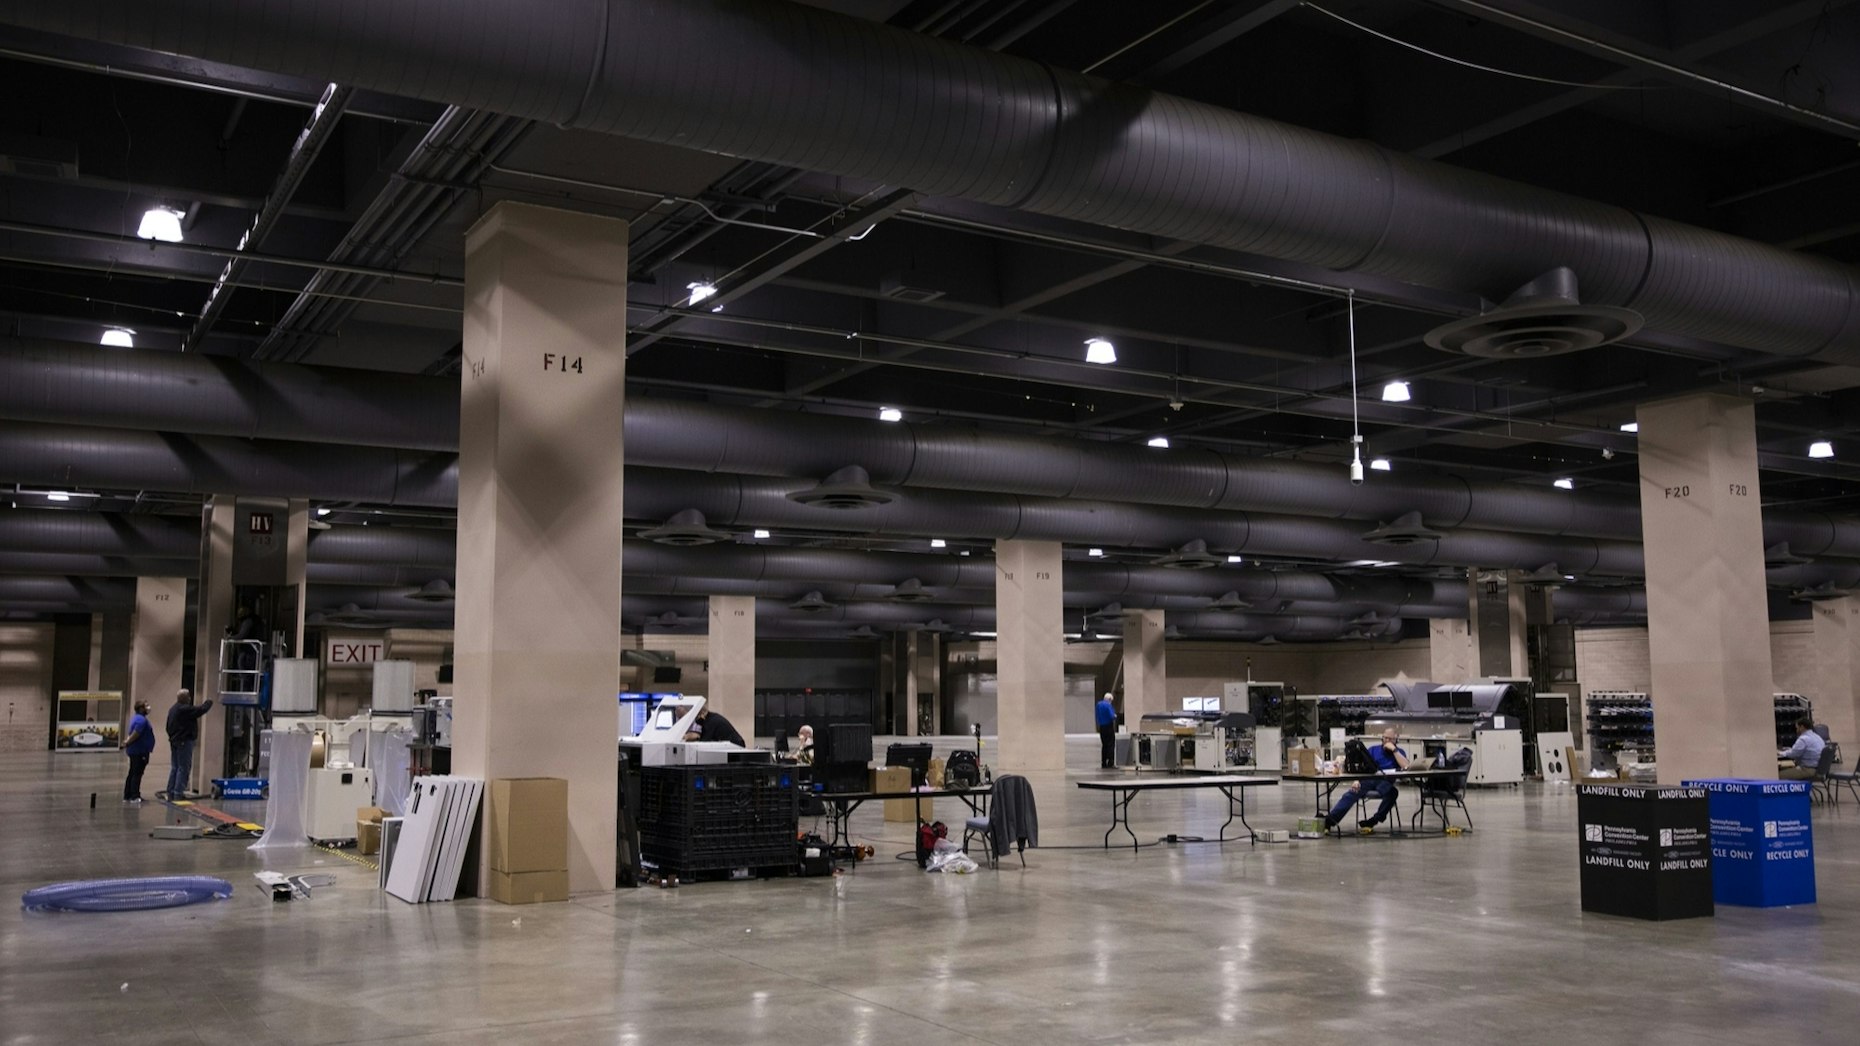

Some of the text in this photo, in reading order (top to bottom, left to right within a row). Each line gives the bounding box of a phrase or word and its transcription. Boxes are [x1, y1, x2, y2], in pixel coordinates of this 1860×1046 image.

[543, 353, 583, 374] F14
[1665, 485, 1690, 499] F20
[1729, 484, 1747, 497] F20
[1036, 571, 1050, 580] F19
[331, 644, 382, 663] EXIT
[1582, 785, 1646, 799] LANDFILL ONLY
[1657, 789, 1706, 799] LANDFILL ONLY
[1725, 783, 1749, 793] ONLY
[1762, 783, 1806, 794] RECYCLE ONLY
[1604, 825, 1637, 835] Pennsylvania
[1604, 831, 1650, 841] Convention Center
[1730, 849, 1754, 860] ONLY
[1766, 849, 1809, 861] RECYCLE ONLY
[1585, 855, 1650, 871] LANDFILL ONLY
[1660, 859, 1708, 871] LANDFILL ONLY
